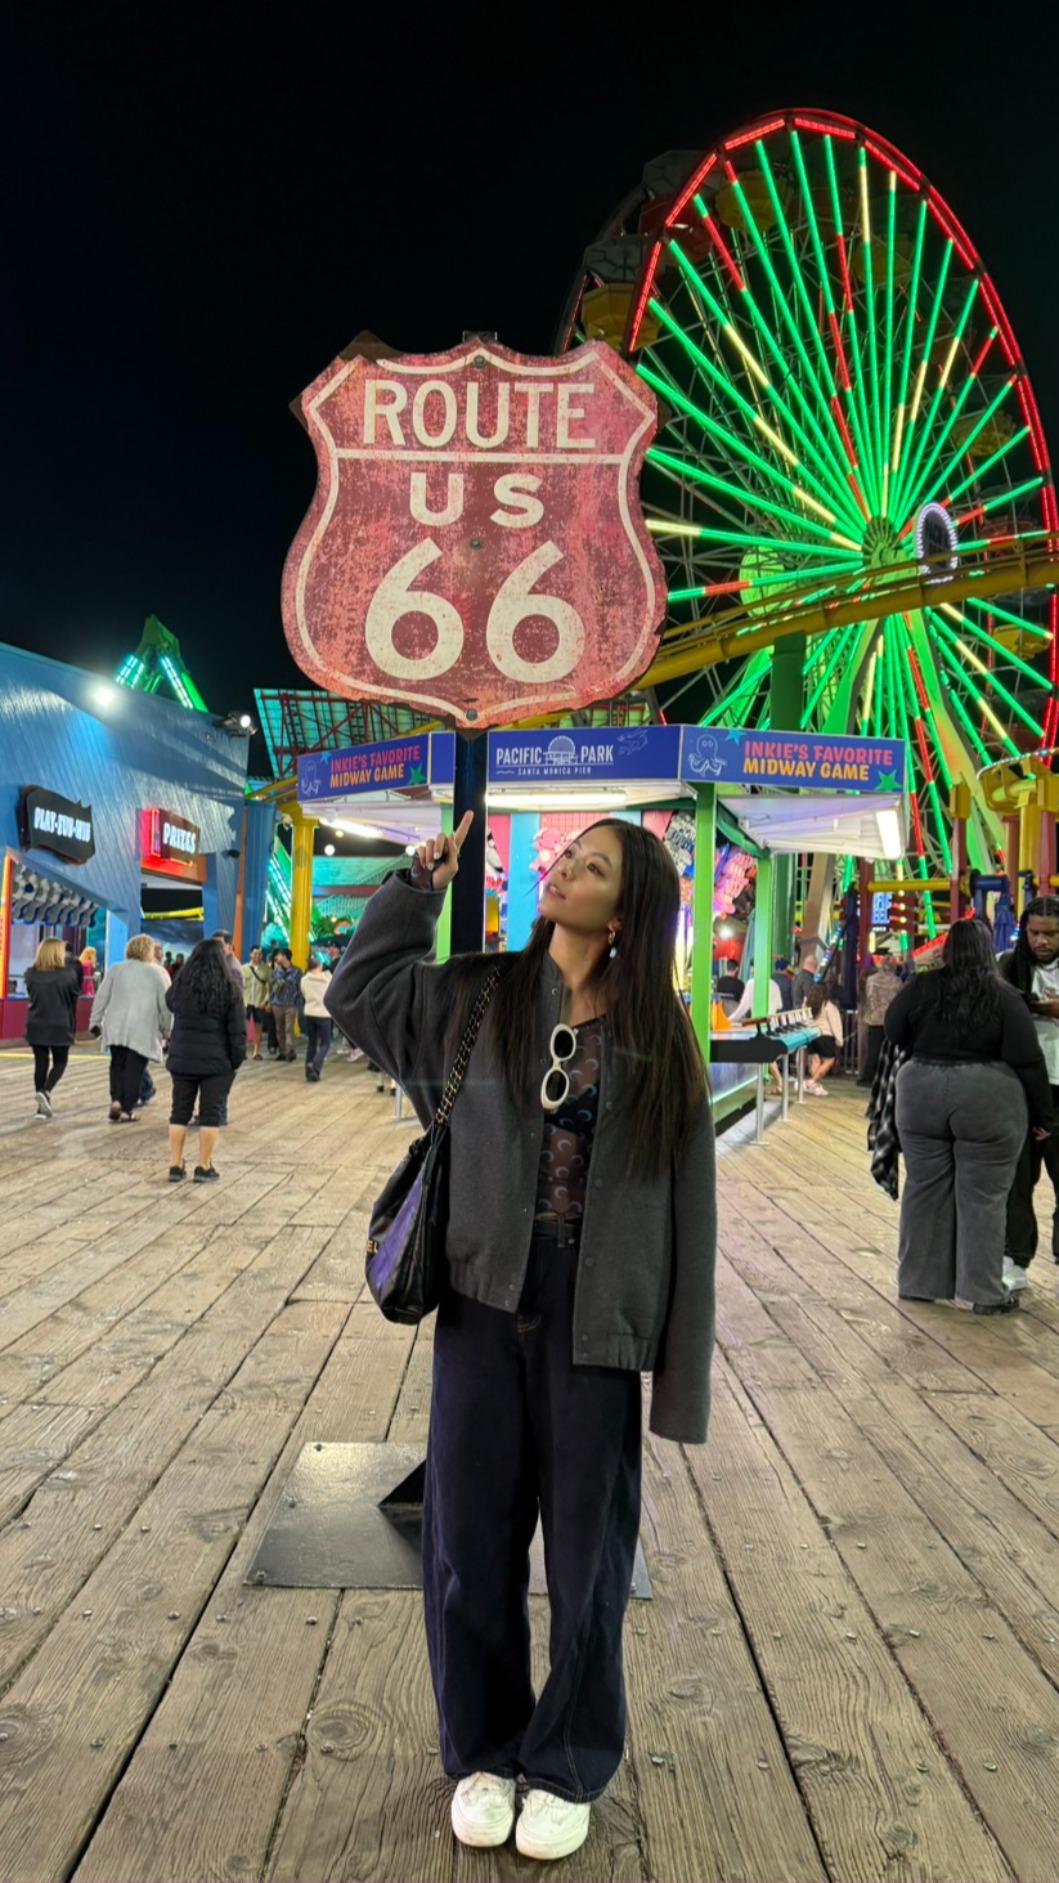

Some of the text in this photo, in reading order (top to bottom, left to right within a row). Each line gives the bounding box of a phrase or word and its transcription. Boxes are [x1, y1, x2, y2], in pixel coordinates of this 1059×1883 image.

[363, 378, 596, 449] ROUTE
[364, 537, 585, 683] 66
[331, 745, 420, 773] INKIE'S FAVORITE
[496, 745, 614, 765] PACIFIC PARK
[744, 741, 893, 765] INKIE'S FAVORITE
[330, 763, 404, 789] MIDWAY GAME
[518, 766, 592, 776] SANTA MONICA PIER
[743, 758, 869, 781] MIDWAY GAME
